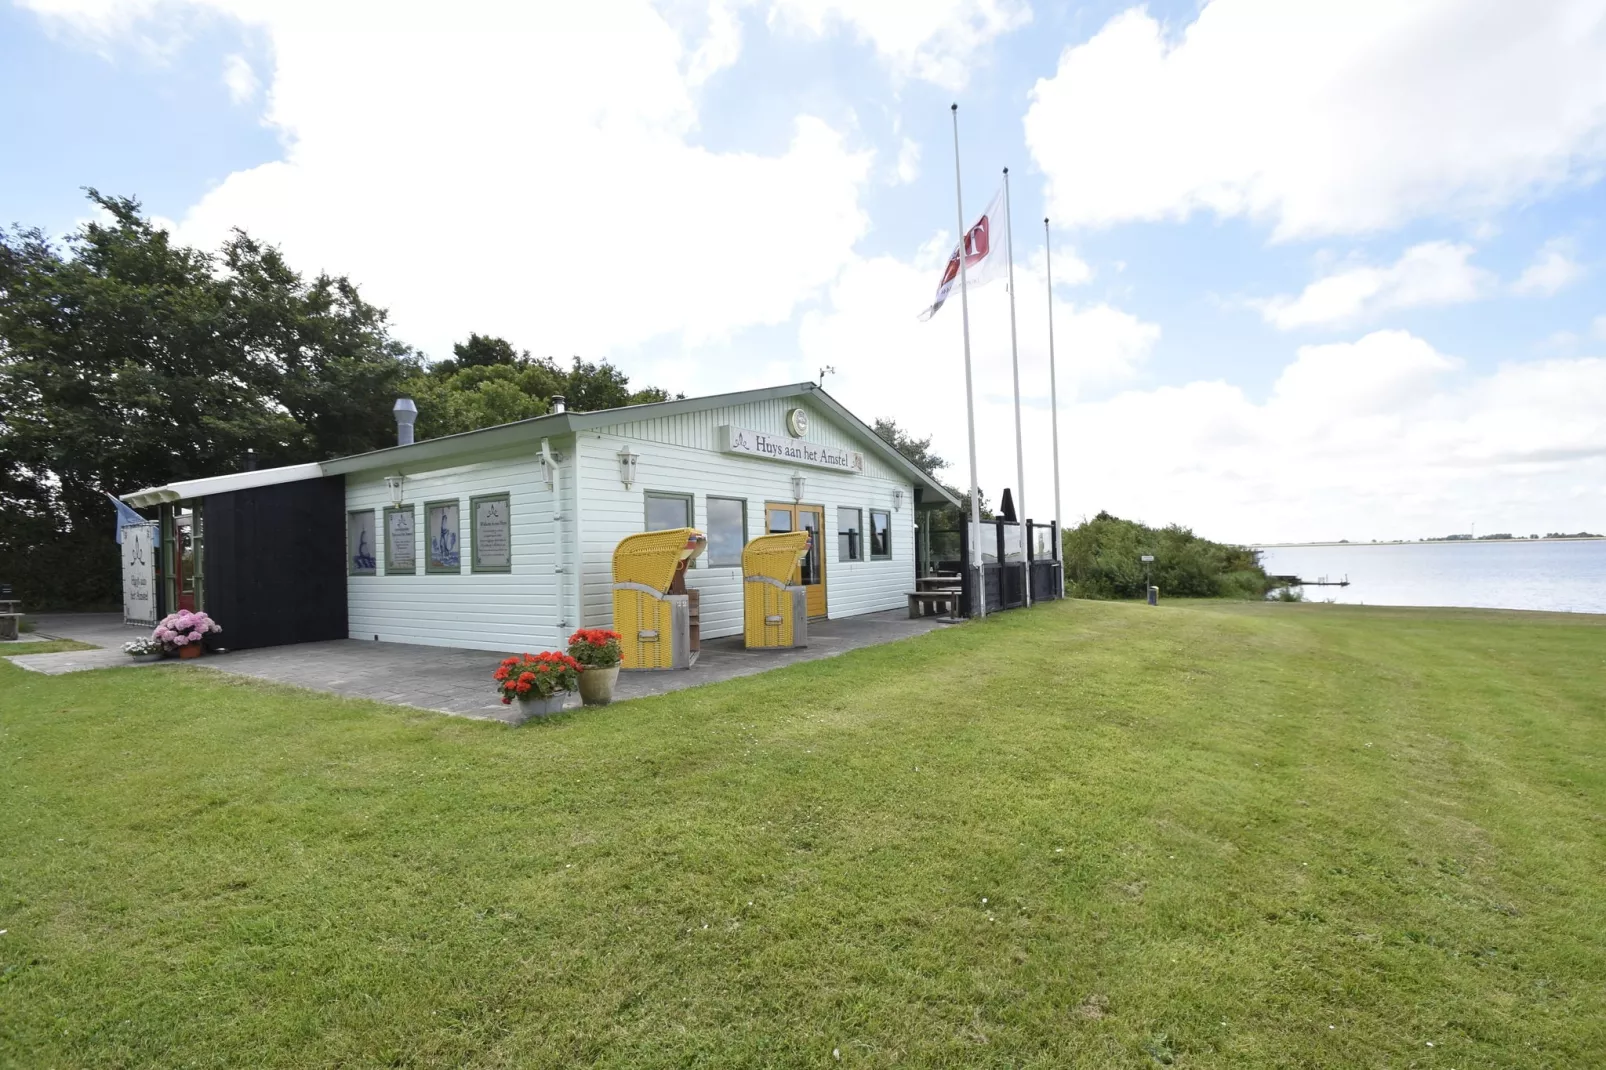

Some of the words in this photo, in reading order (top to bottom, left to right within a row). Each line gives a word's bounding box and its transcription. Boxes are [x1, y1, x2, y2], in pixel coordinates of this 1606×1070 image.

[756, 436, 782, 457] Huys
[784, 446, 802, 459] aan
[803, 445, 817, 462] het
[820, 449, 848, 467] Amstel
